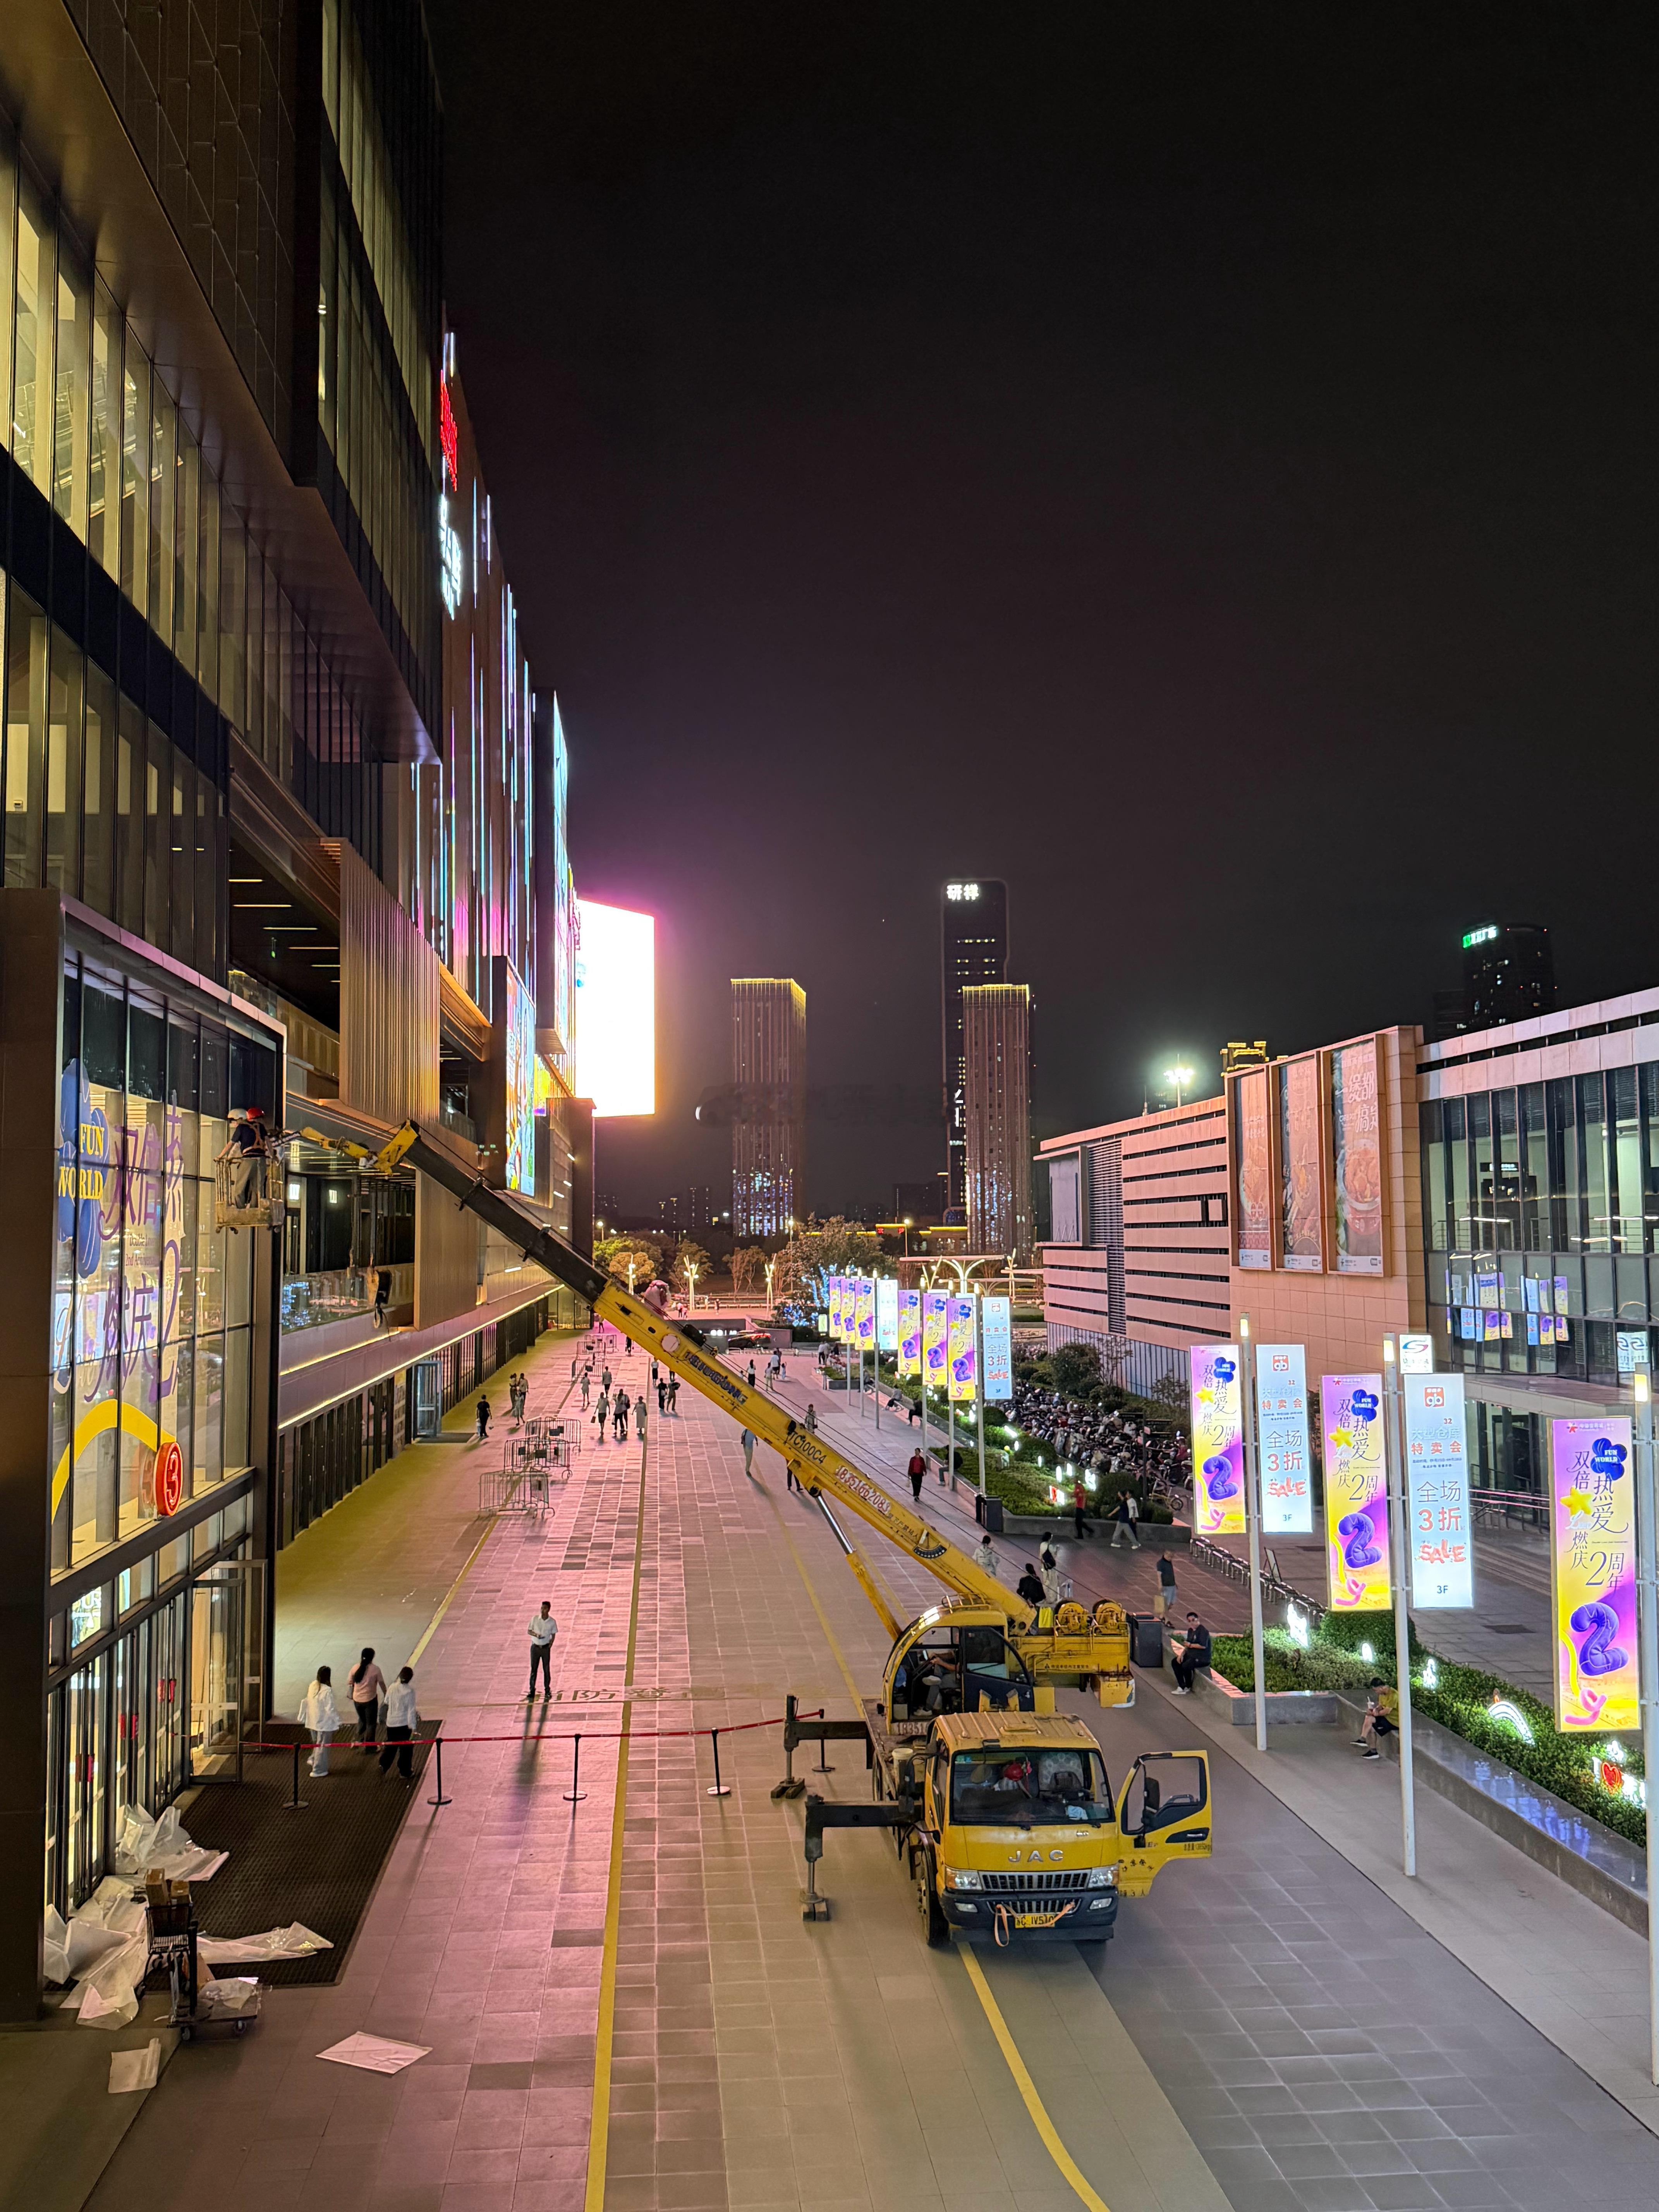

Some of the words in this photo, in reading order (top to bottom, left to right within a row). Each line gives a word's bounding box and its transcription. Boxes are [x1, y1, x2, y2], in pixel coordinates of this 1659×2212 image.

[80, 1123, 104, 1156] FUN
[58, 1166, 103, 1199] WORLD
[988, 1355, 1007, 1366] 3折
[1199, 1365, 1214, 1388] 双倍
[1214, 1379, 1237, 1414] 热爱
[1333, 1399, 1351, 1428] 双倍
[1266, 1430, 1302, 1448] 全场
[1351, 1417, 1381, 1461] 热爱
[1411, 1427, 1462, 1440] 大型仓库
[1411, 1440, 1462, 1455] 特卖会
[1267, 1451, 1302, 1471] 3折
[1332, 1459, 1350, 1488] 燃庆
[1566, 1451, 1590, 1490] 双倍
[1417, 1480, 1461, 1503] 全场
[1591, 1473, 1628, 1534] 热爱
[1419, 1506, 1462, 1531] 3折
[1419, 1539, 1466, 1564] SALE
[1564, 1531, 1589, 1570] 燃庆
[1437, 1585, 1448, 1594] 3F
[1008, 1850, 1064, 1862] JAC
